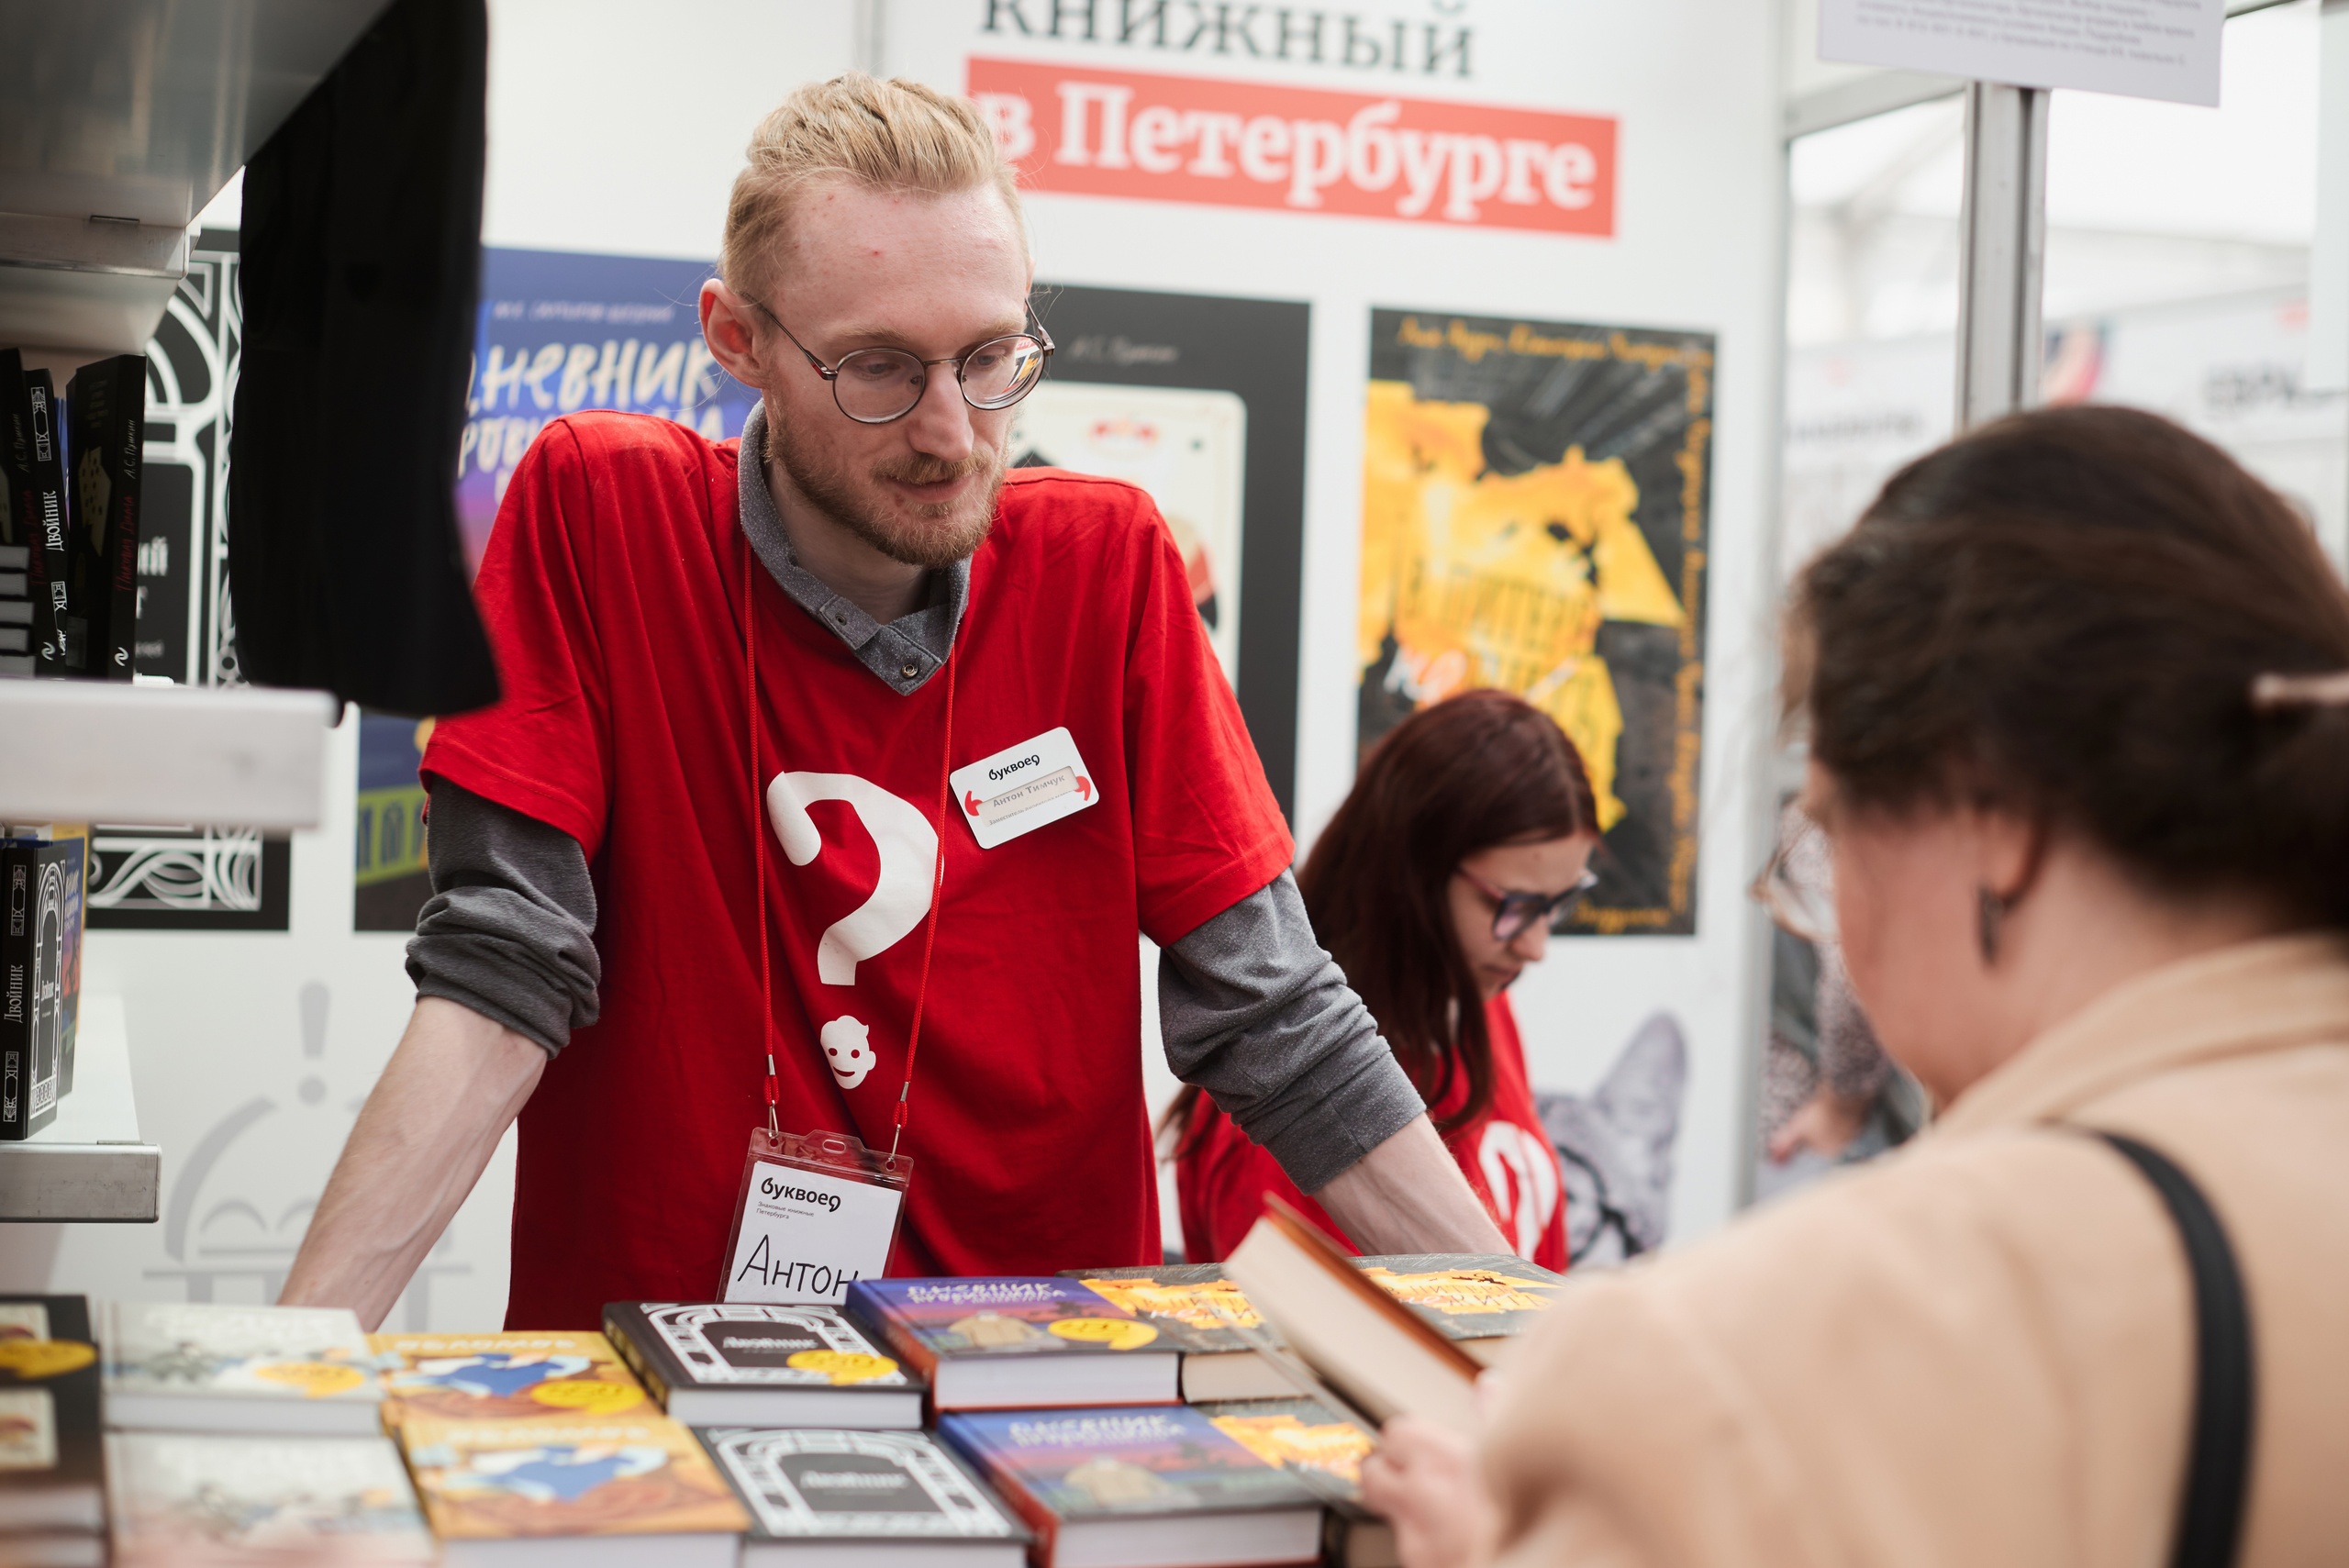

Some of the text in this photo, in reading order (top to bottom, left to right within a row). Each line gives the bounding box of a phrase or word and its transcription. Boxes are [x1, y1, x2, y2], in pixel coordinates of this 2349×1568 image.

[1056, 81, 1598, 222] Петербурге
[988, 754, 1041, 781] буквоед
[993, 791, 1024, 807] Антон
[1025, 775, 1065, 795] Тимчук
[4, 963, 24, 1024] Двойник
[757, 1200, 815, 1218] Знаковые книжные
[761, 1176, 841, 1213] буквоед
[756, 1207, 790, 1219] Петербурга
